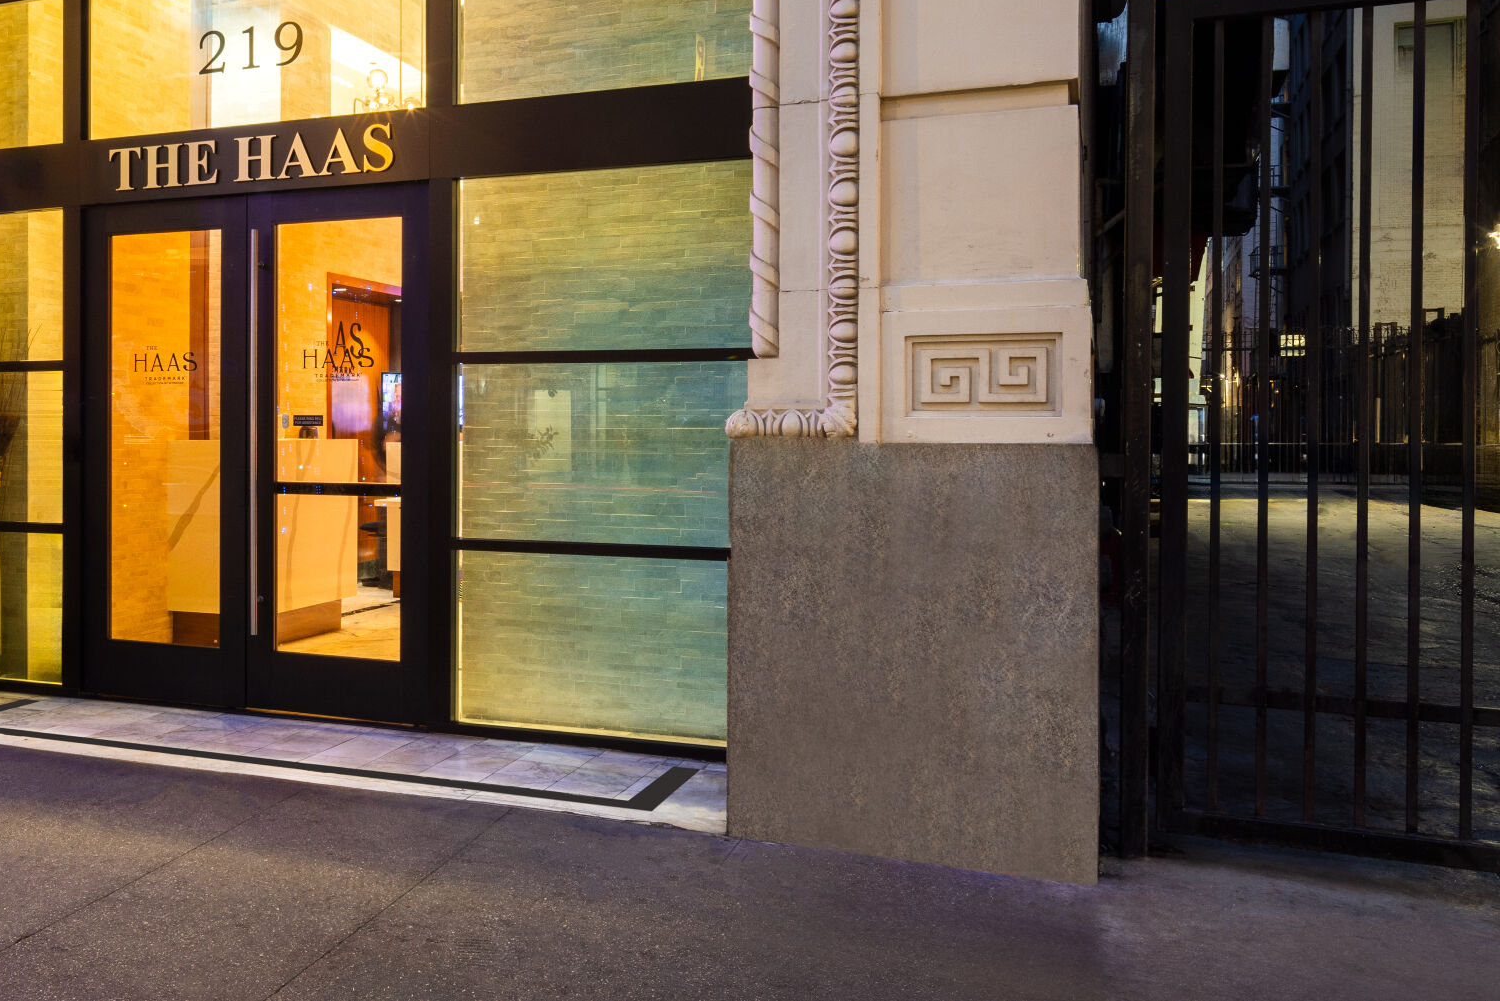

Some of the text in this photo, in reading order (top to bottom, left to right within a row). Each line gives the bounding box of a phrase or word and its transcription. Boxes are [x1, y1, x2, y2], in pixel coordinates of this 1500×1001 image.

[198, 21, 304, 75] 219
[108, 122, 395, 192] THE HAAS
[133, 351, 198, 373] HAAS
[302, 347, 375, 370] HAAS
